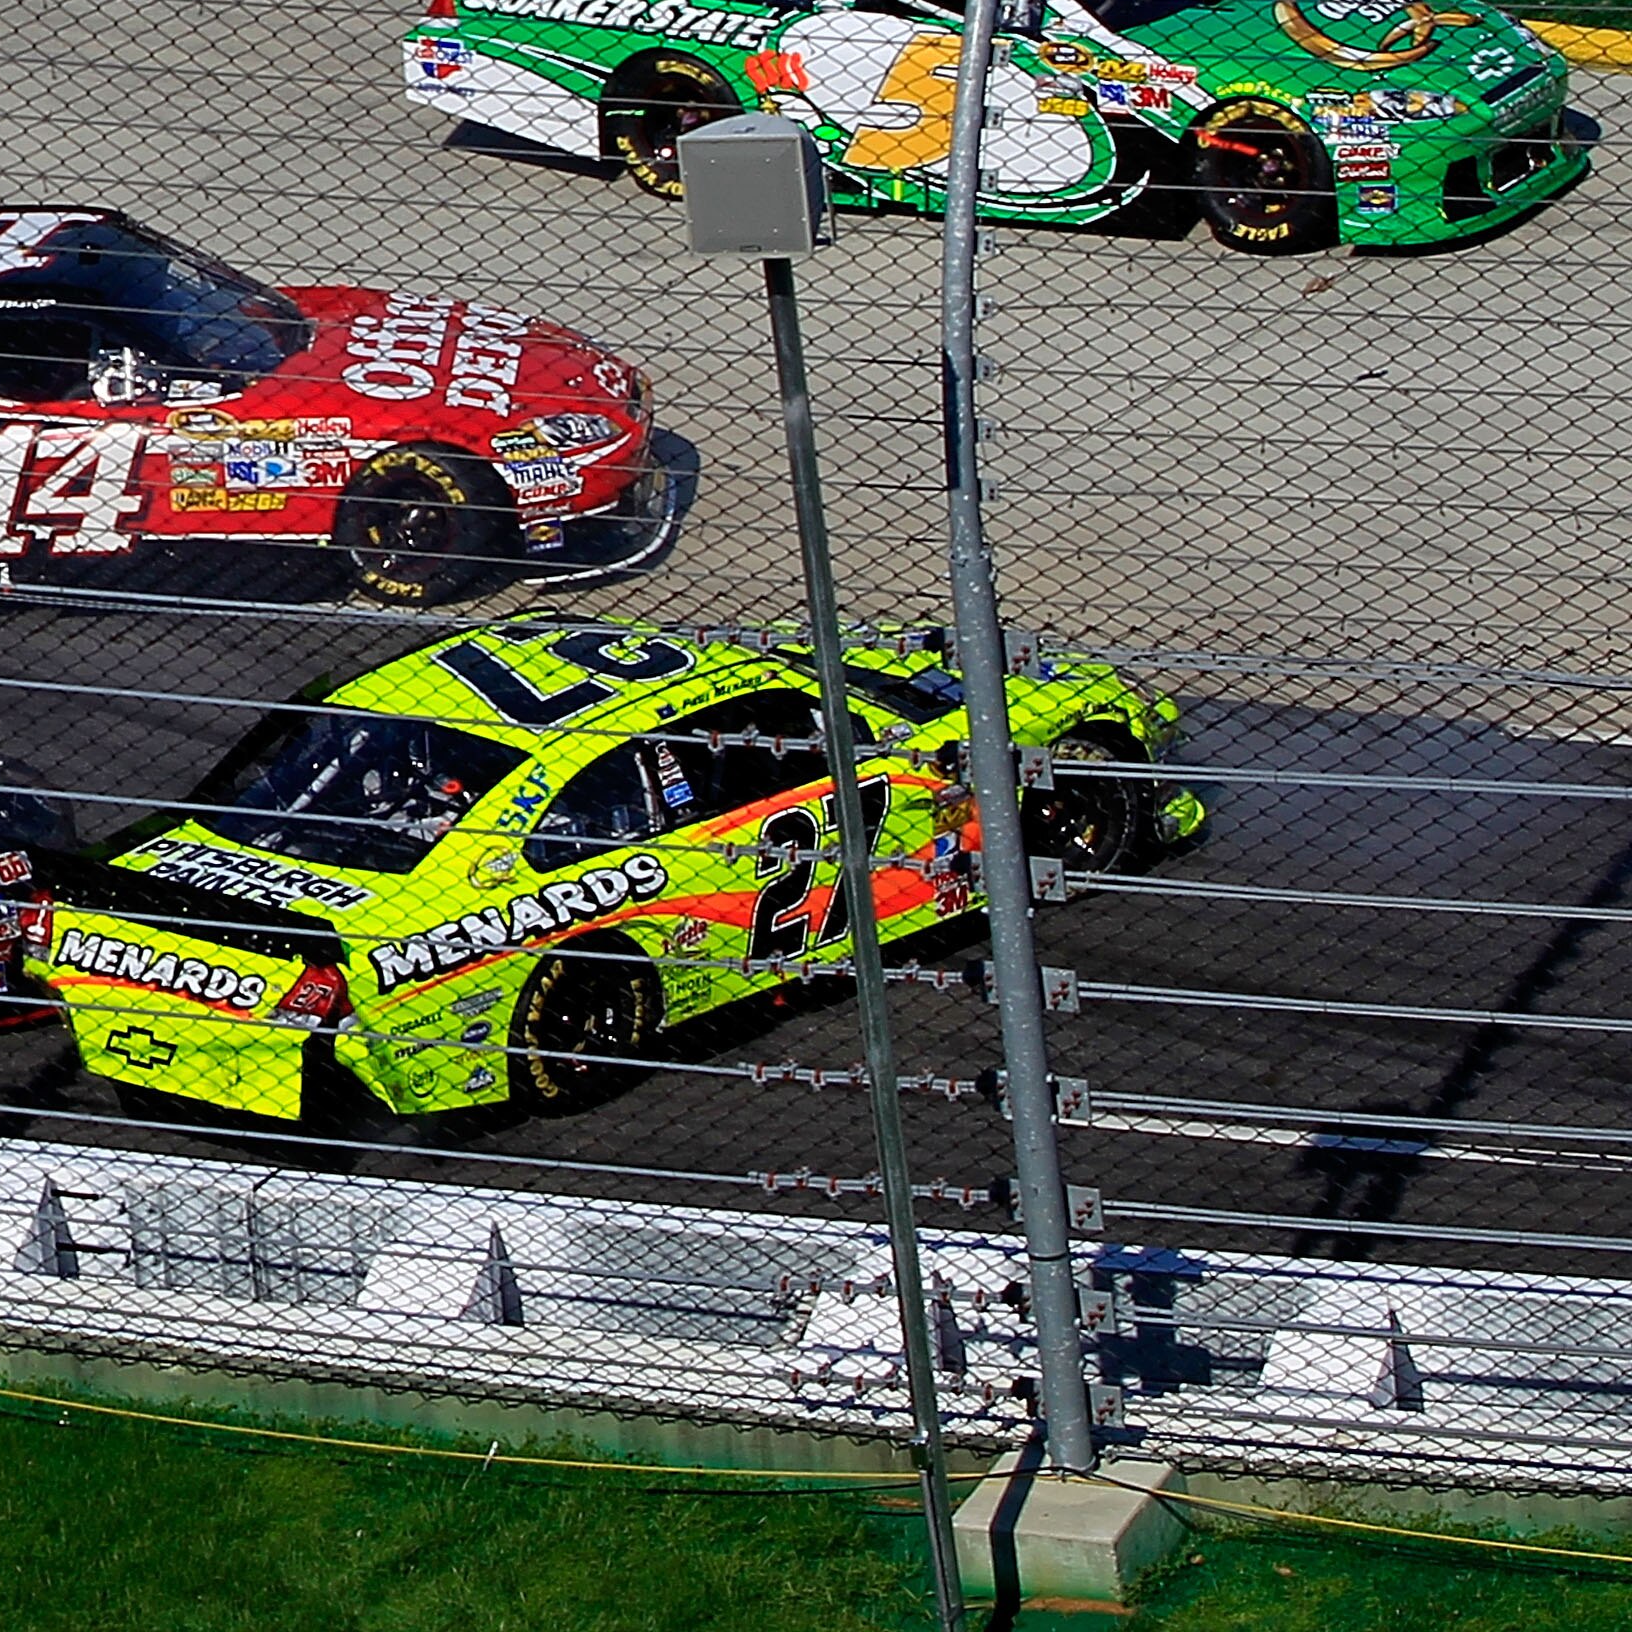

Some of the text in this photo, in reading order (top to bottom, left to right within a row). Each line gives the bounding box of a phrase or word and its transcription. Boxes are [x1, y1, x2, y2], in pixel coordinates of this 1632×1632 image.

[1129, 85, 1170, 110] 3M
[342, 289, 455, 402] Office
[445, 303, 531, 418] DEPOT
[498, 763, 552, 835] SKF
[149, 862, 296, 909] PAINTS
[747, 774, 891, 960] 27
[372, 852, 667, 994] MENARDS
[58, 931, 266, 1008] MENARDS
[292, 982, 333, 1009] 27
